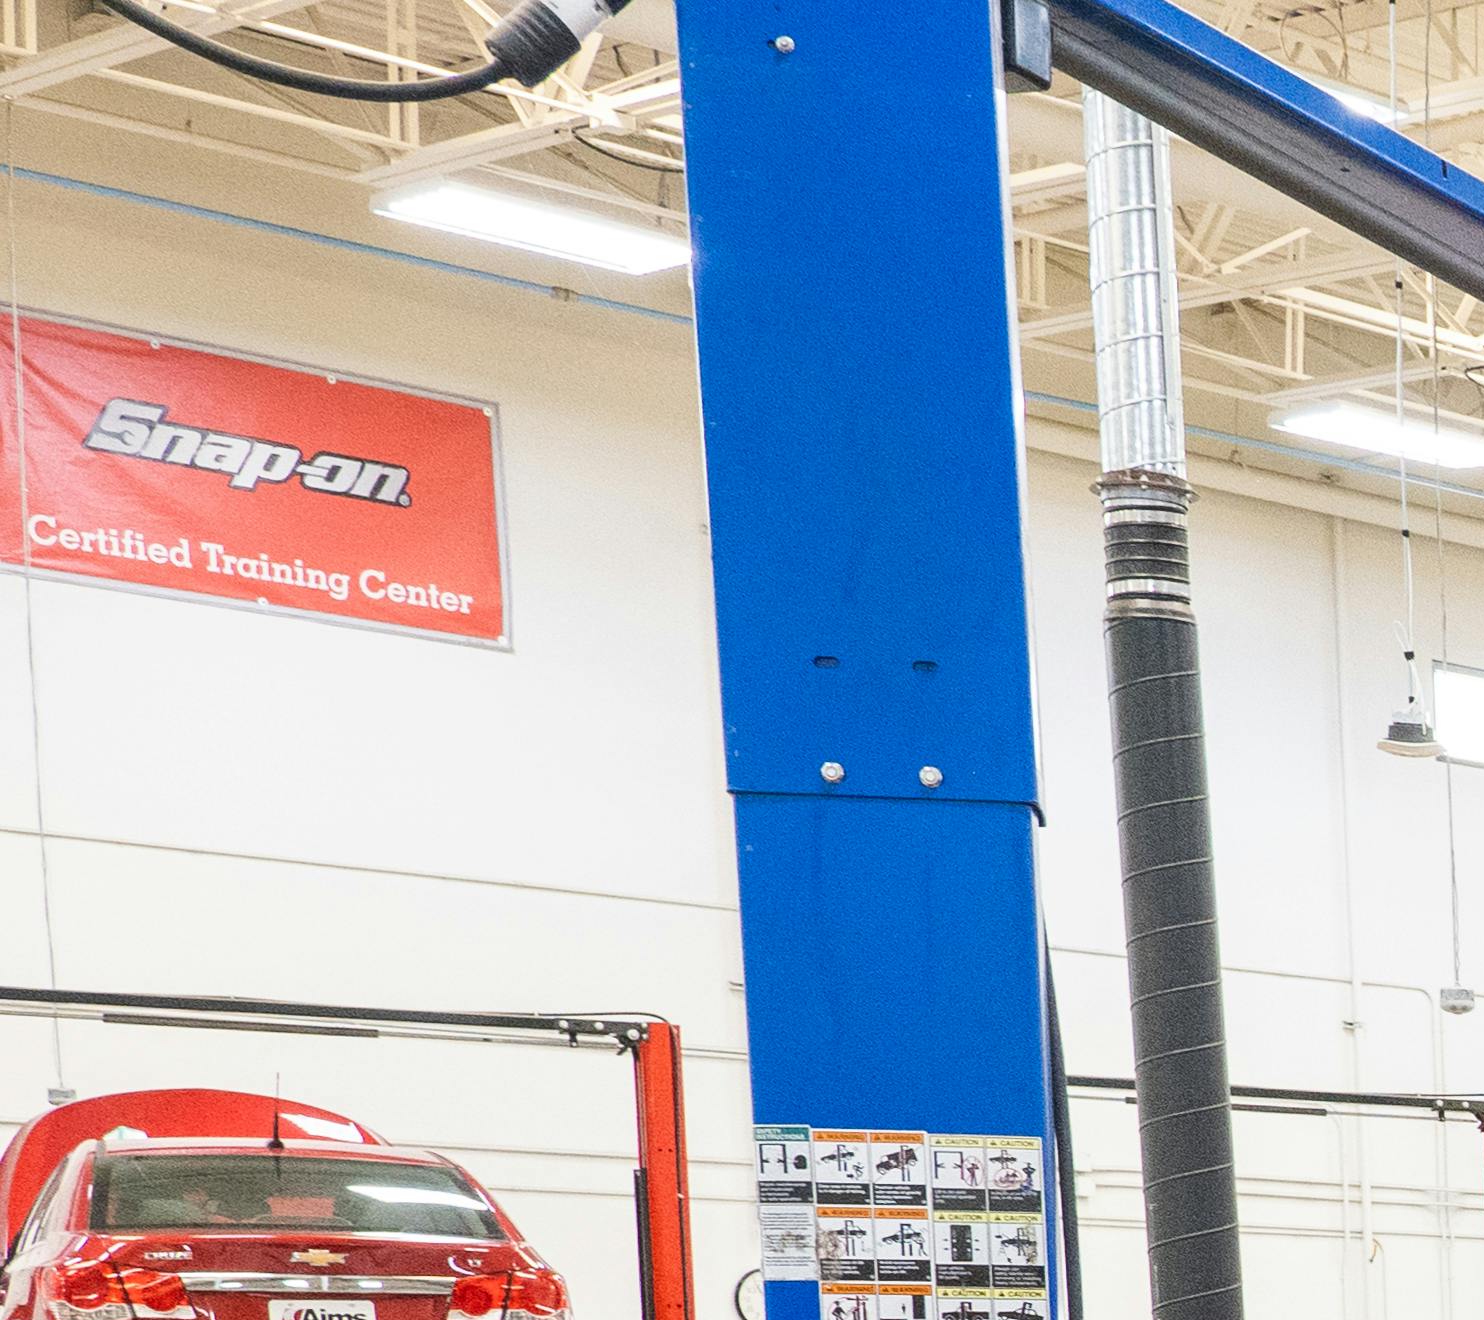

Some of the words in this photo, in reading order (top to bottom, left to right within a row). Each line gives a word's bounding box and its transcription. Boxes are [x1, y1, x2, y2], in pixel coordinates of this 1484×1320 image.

[84, 397, 411, 507] Snap-on
[28, 515, 192, 569] Certified
[199, 543, 350, 600] Training
[360, 569, 474, 615] Center
